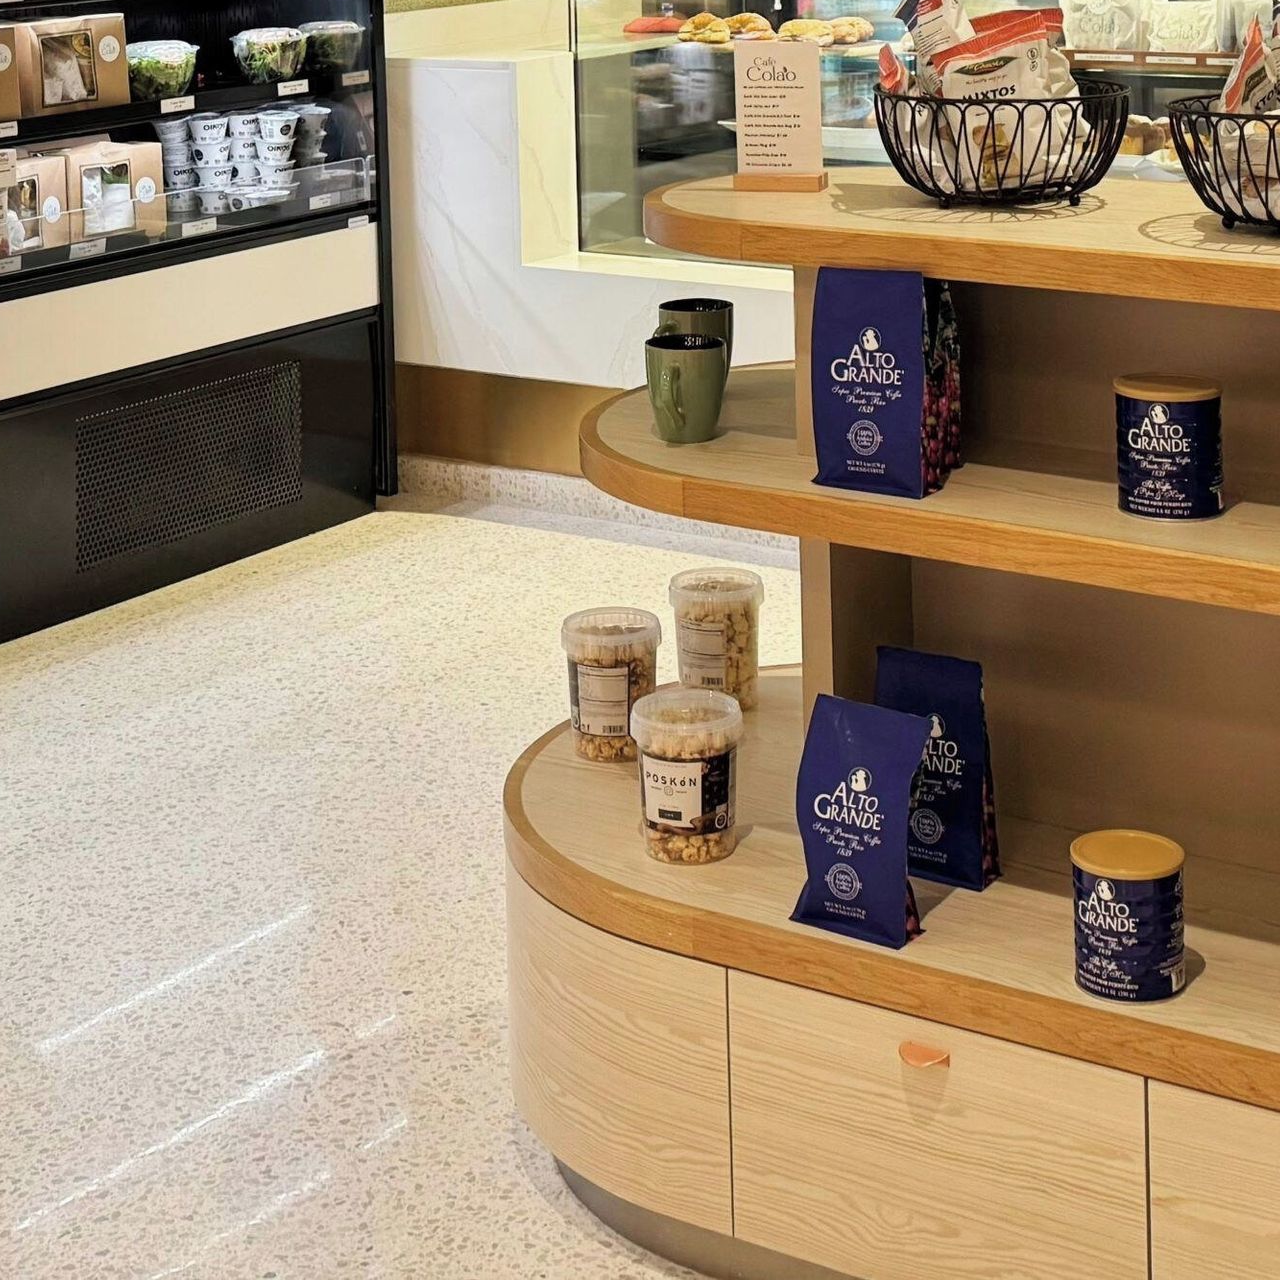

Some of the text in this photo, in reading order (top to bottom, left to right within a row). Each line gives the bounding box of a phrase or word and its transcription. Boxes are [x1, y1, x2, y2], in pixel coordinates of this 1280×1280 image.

[746, 66, 796, 82] Colao
[846, 344, 895, 368] ALTO
[830, 358, 902, 385] GRANDE
[1140, 417, 1183, 439] ALTO
[1128, 429, 1190, 452] GRANDE
[929, 739, 958, 757] LTO
[830, 782, 878, 813] ALTO
[814, 793, 881, 831] GRANDE
[1078, 900, 1137, 933] GRANDE
[1088, 892, 1129, 917] ALTO
